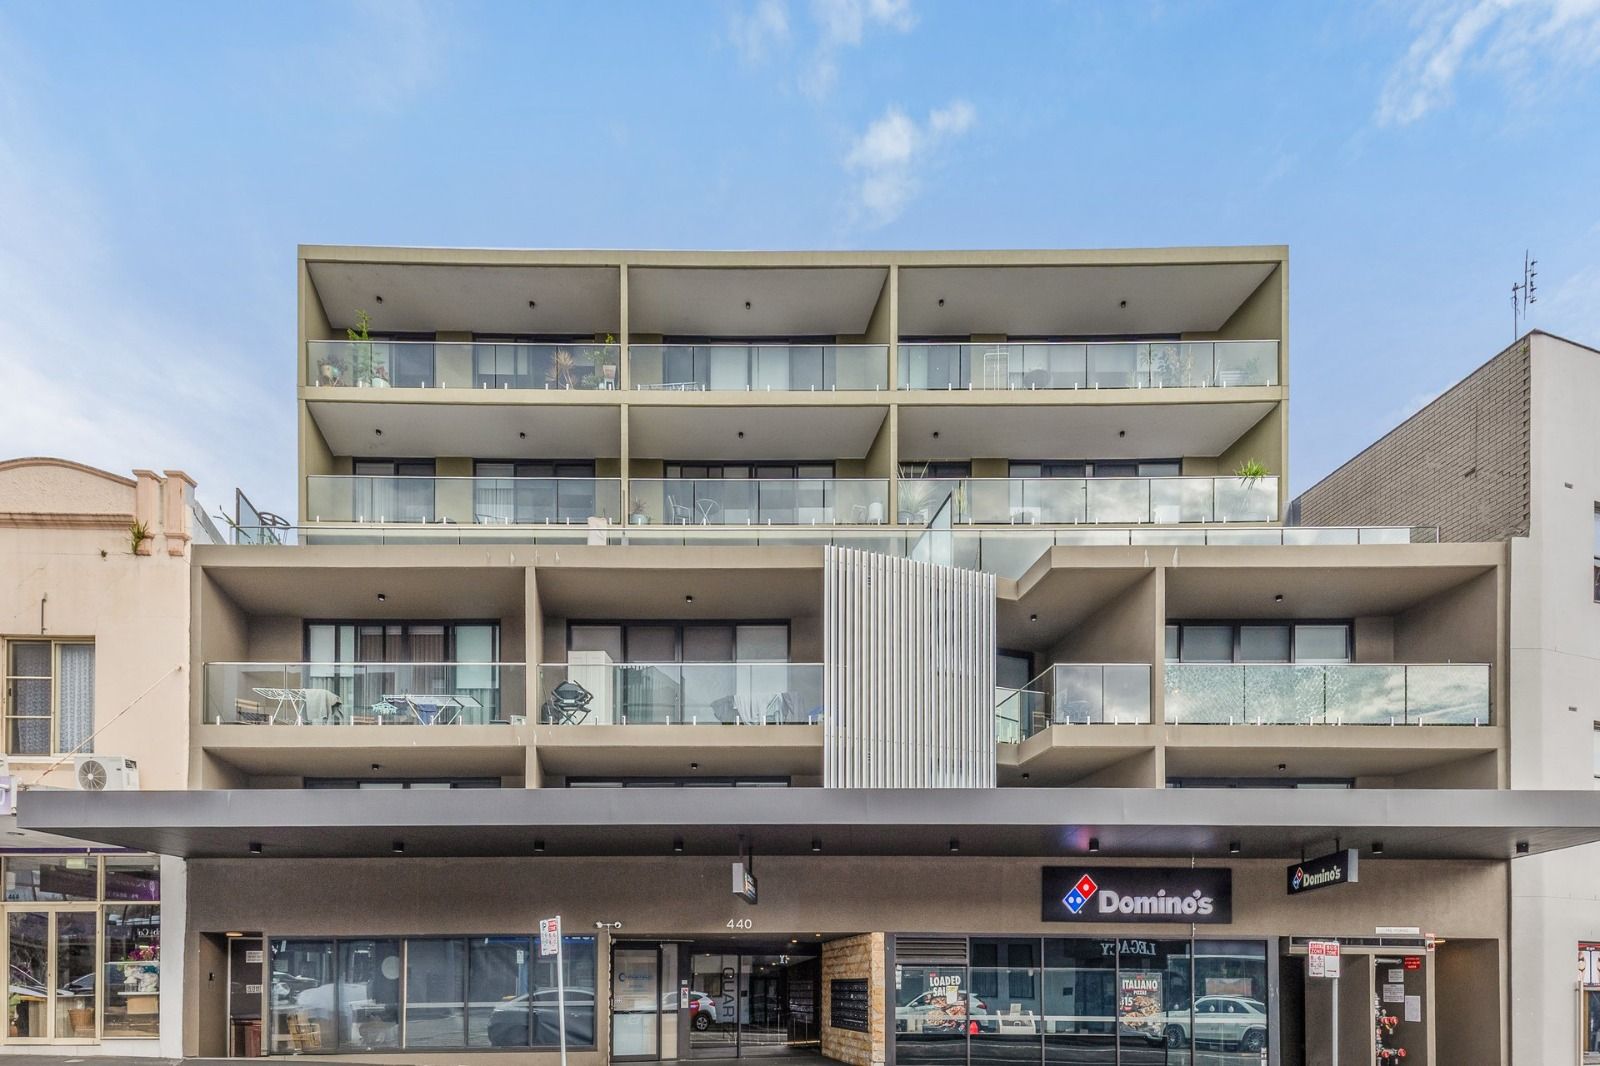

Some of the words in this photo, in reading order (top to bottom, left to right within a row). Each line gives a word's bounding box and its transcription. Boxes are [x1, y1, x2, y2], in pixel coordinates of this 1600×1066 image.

[1303, 865, 1341, 887] Domino's
[1098, 889, 1214, 915] Domino's
[726, 919, 752, 929] 440
[929, 975, 961, 987] LOADED
[1122, 979, 1158, 990] ITALIANO
